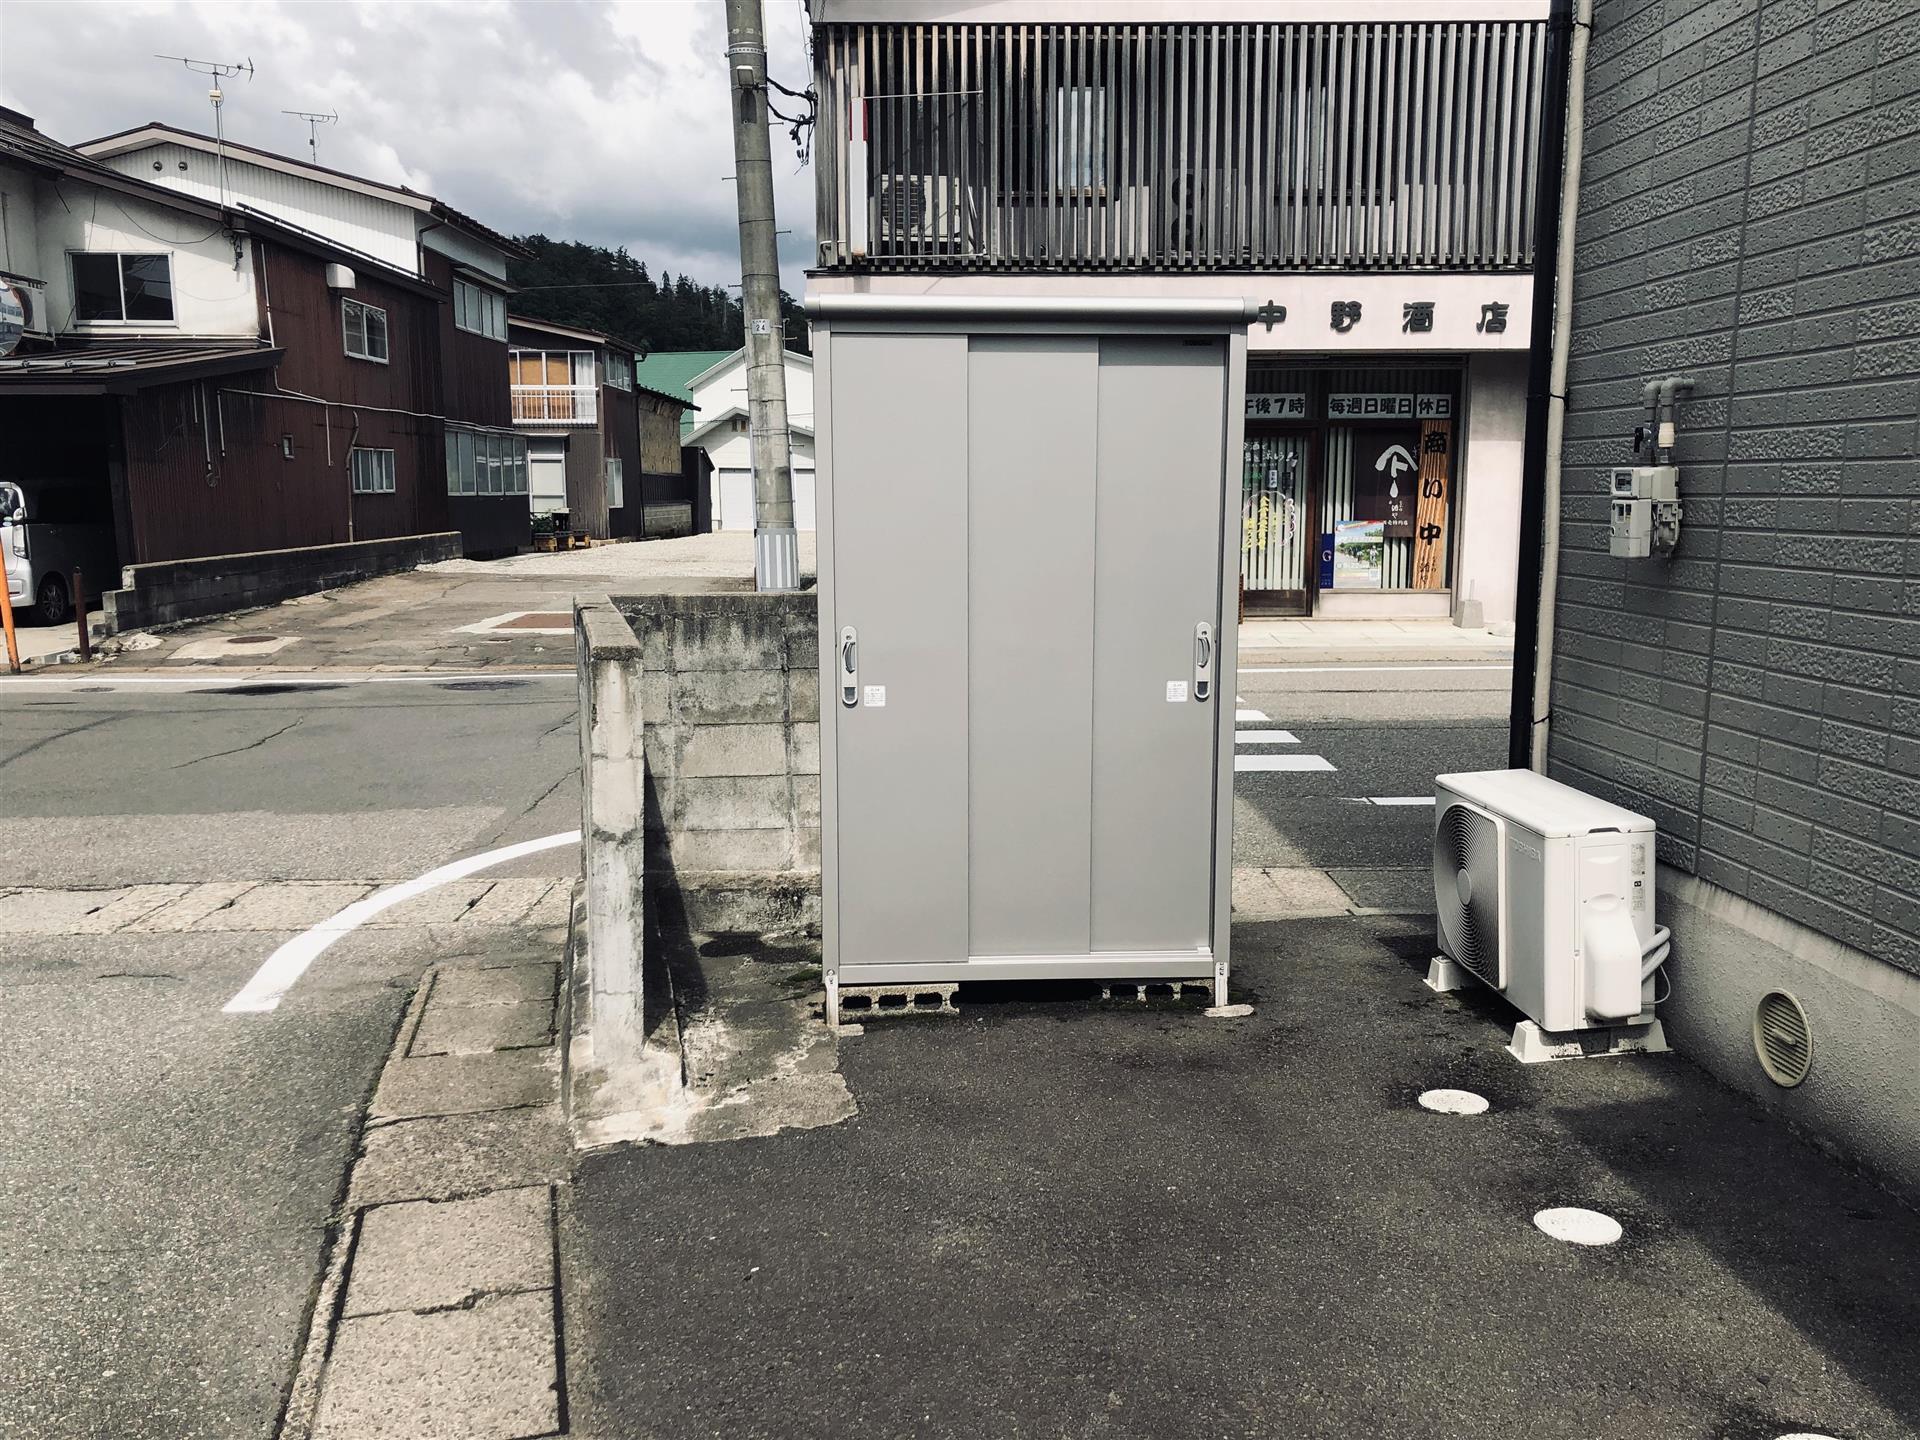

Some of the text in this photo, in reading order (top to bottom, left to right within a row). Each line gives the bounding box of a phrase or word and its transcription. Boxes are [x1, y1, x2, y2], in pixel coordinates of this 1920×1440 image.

[1258, 299, 1510, 333] 中野酒店
[1329, 397, 1450, 414] 毎週日曜日 休日
[1420, 431, 1447, 545] 商い中
